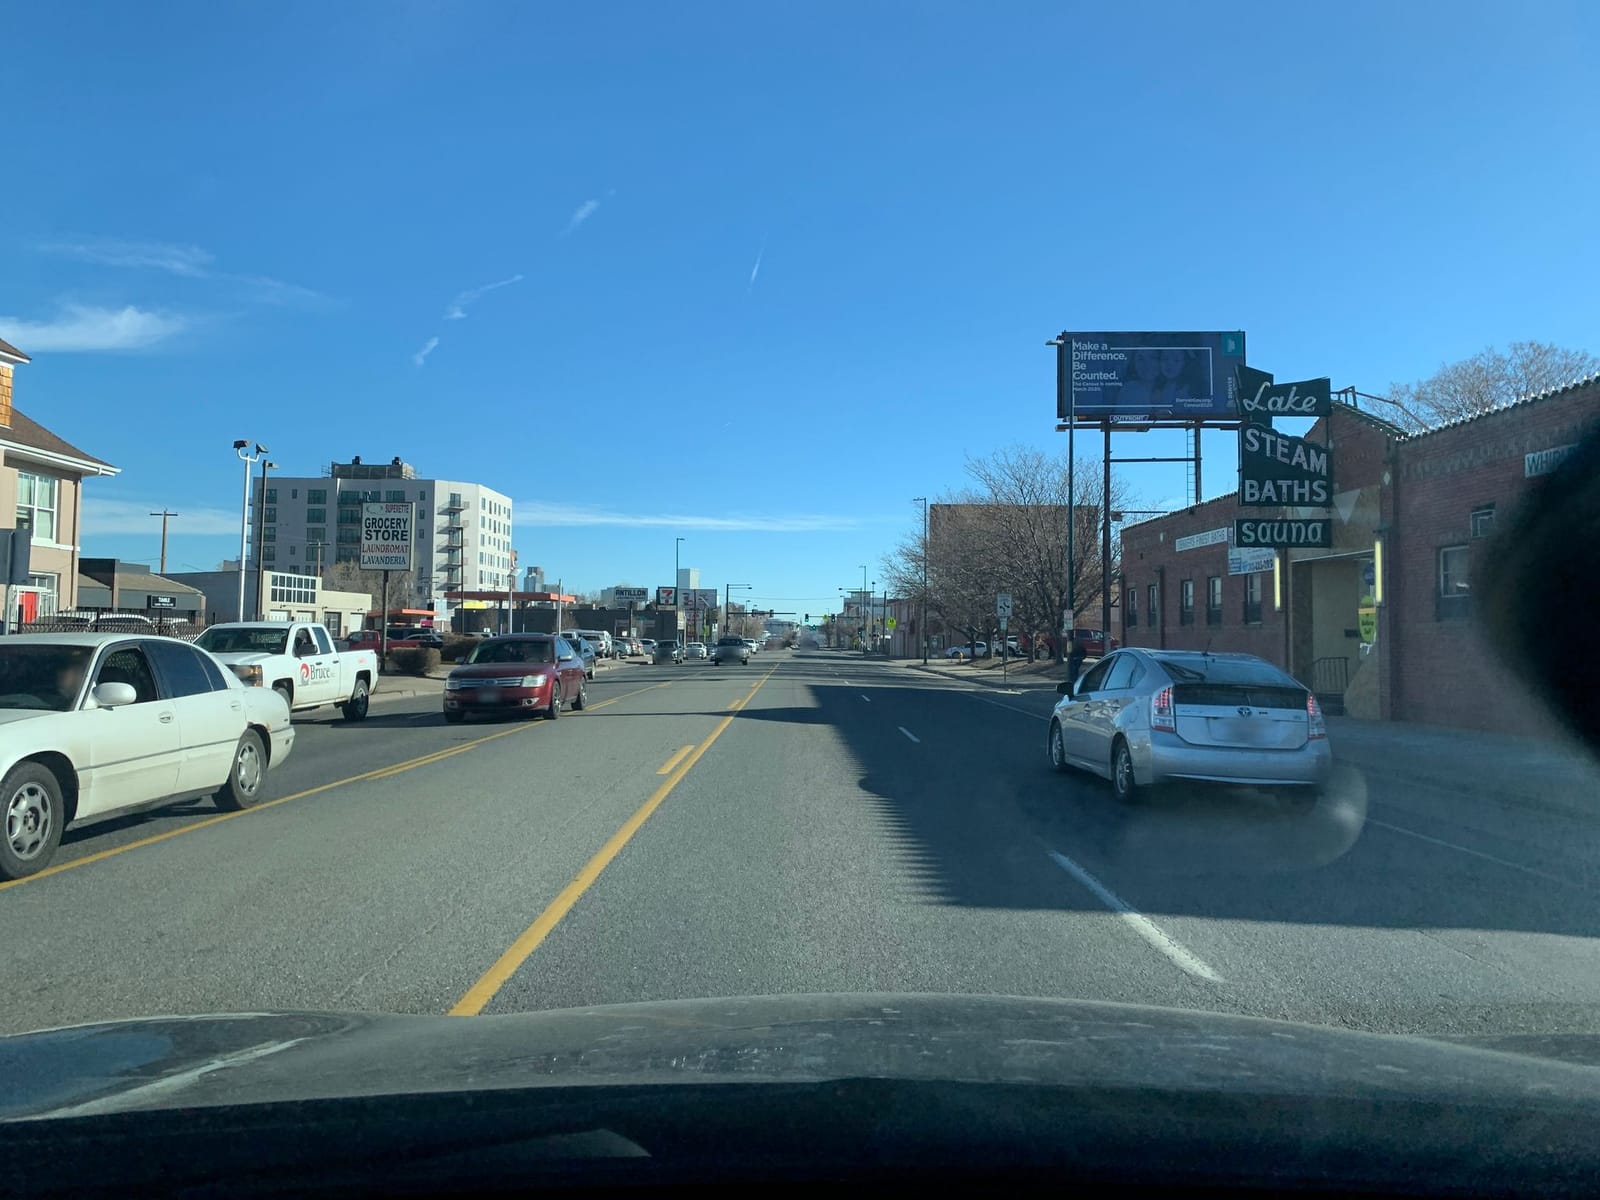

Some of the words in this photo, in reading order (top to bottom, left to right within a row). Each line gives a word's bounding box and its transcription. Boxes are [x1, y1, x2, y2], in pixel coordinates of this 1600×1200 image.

[1073, 341, 1099, 350] Make
[1073, 351, 1127, 360] Difference.
[1073, 361, 1087, 370] Be
[1073, 370, 1119, 380] Counted.
[1243, 382, 1317, 413] Lake
[1245, 428, 1327, 476] STEAM
[1245, 480, 1327, 502] BATHS
[364, 517, 408, 529] GROCERY
[365, 530, 408, 541] STORE
[362, 544, 409, 553] LAUNDROMAT
[361, 555, 406, 565] LAVANDERIA
[310, 664, 331, 680] Bruce
